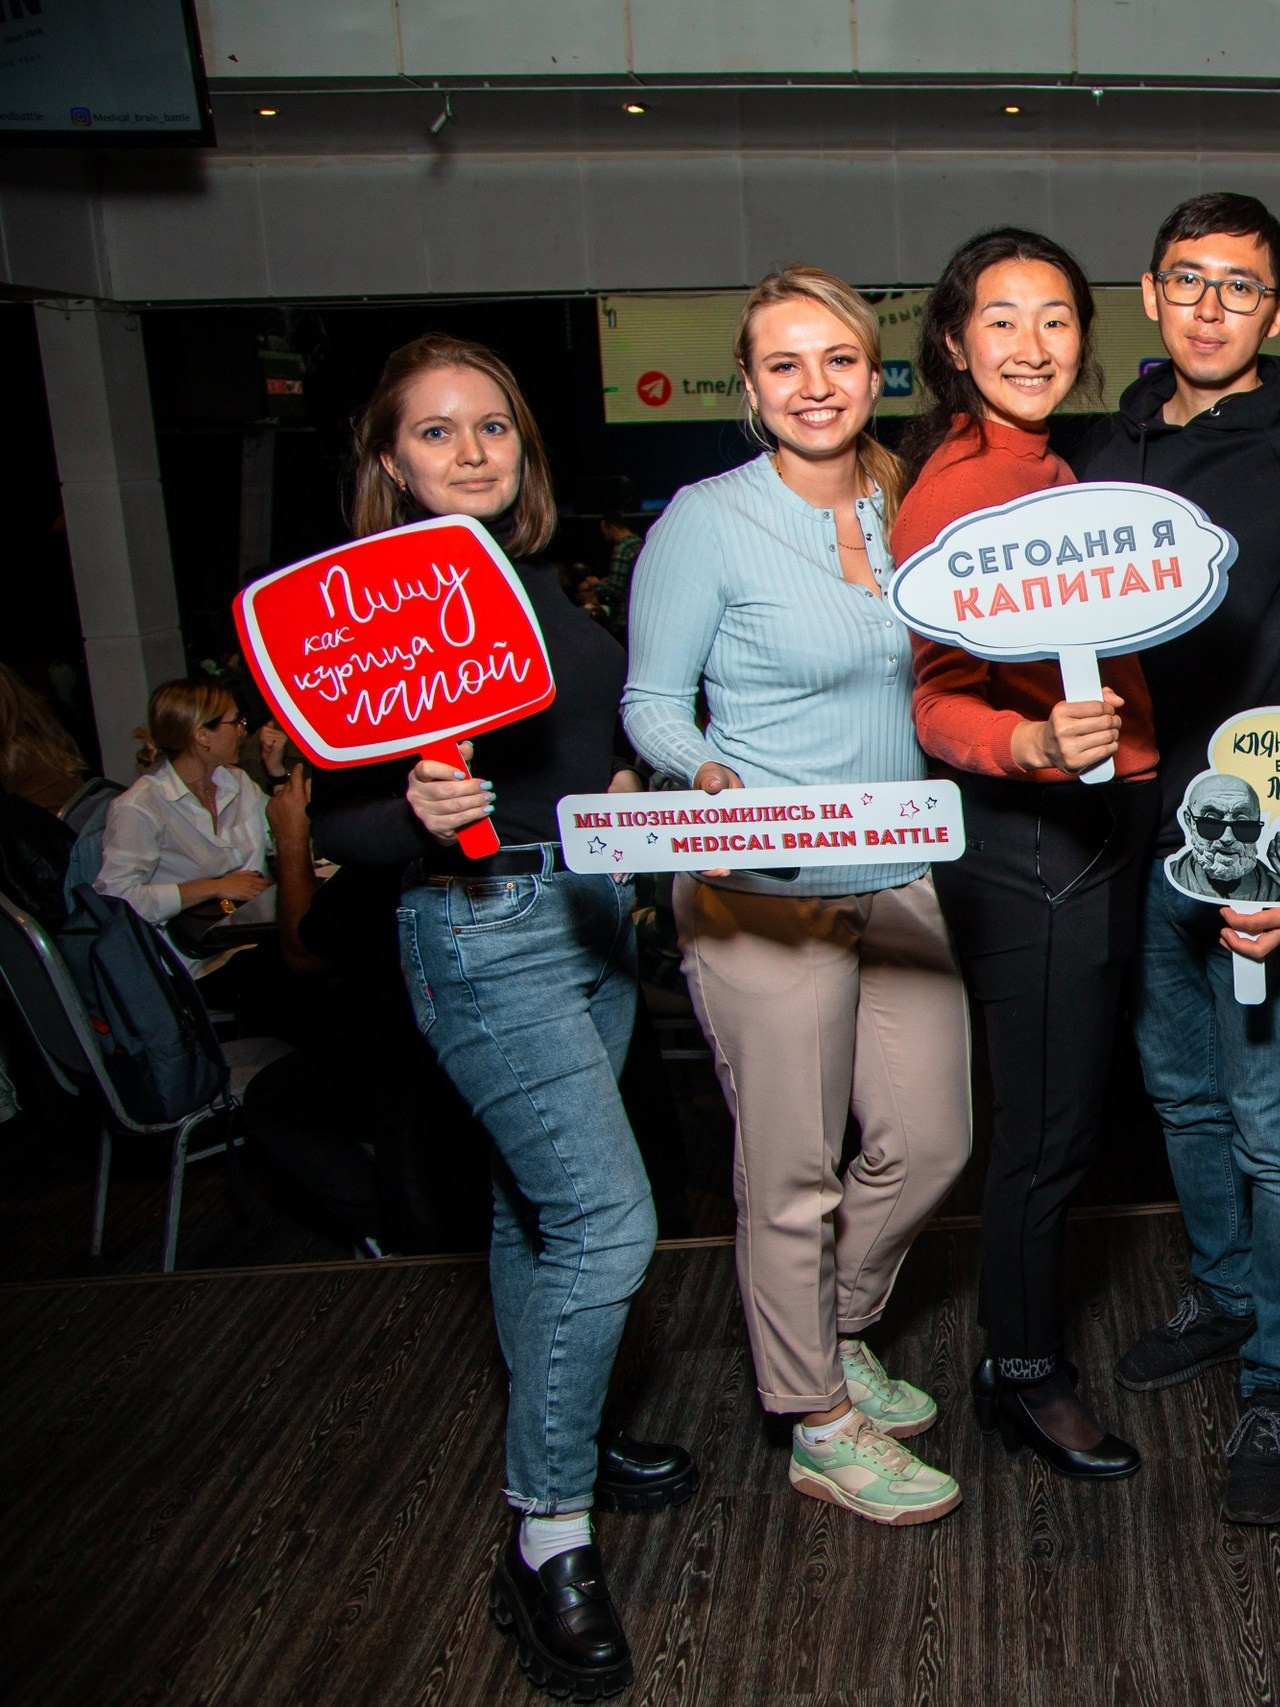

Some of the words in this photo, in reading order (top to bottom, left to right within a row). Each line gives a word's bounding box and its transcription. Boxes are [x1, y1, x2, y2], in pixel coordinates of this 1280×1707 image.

[947, 525, 1137, 578] СЕГОДНЯ
[1152, 519, 1177, 548] Я
[319, 562, 476, 648] Пишу
[953, 556, 1183, 622] КАПИТАН
[293, 635, 434, 702] курица
[304, 626, 355, 656] как
[346, 641, 531, 726] лапой
[573, 811, 613, 830] МЫ
[616, 804, 816, 828] ПОЗНАКОМИЛИСЬ
[820, 803, 854, 820] НА
[670, 832, 776, 854] MEDICAL
[782, 830, 857, 849] BRAIN
[864, 826, 949, 846] BATTLE
